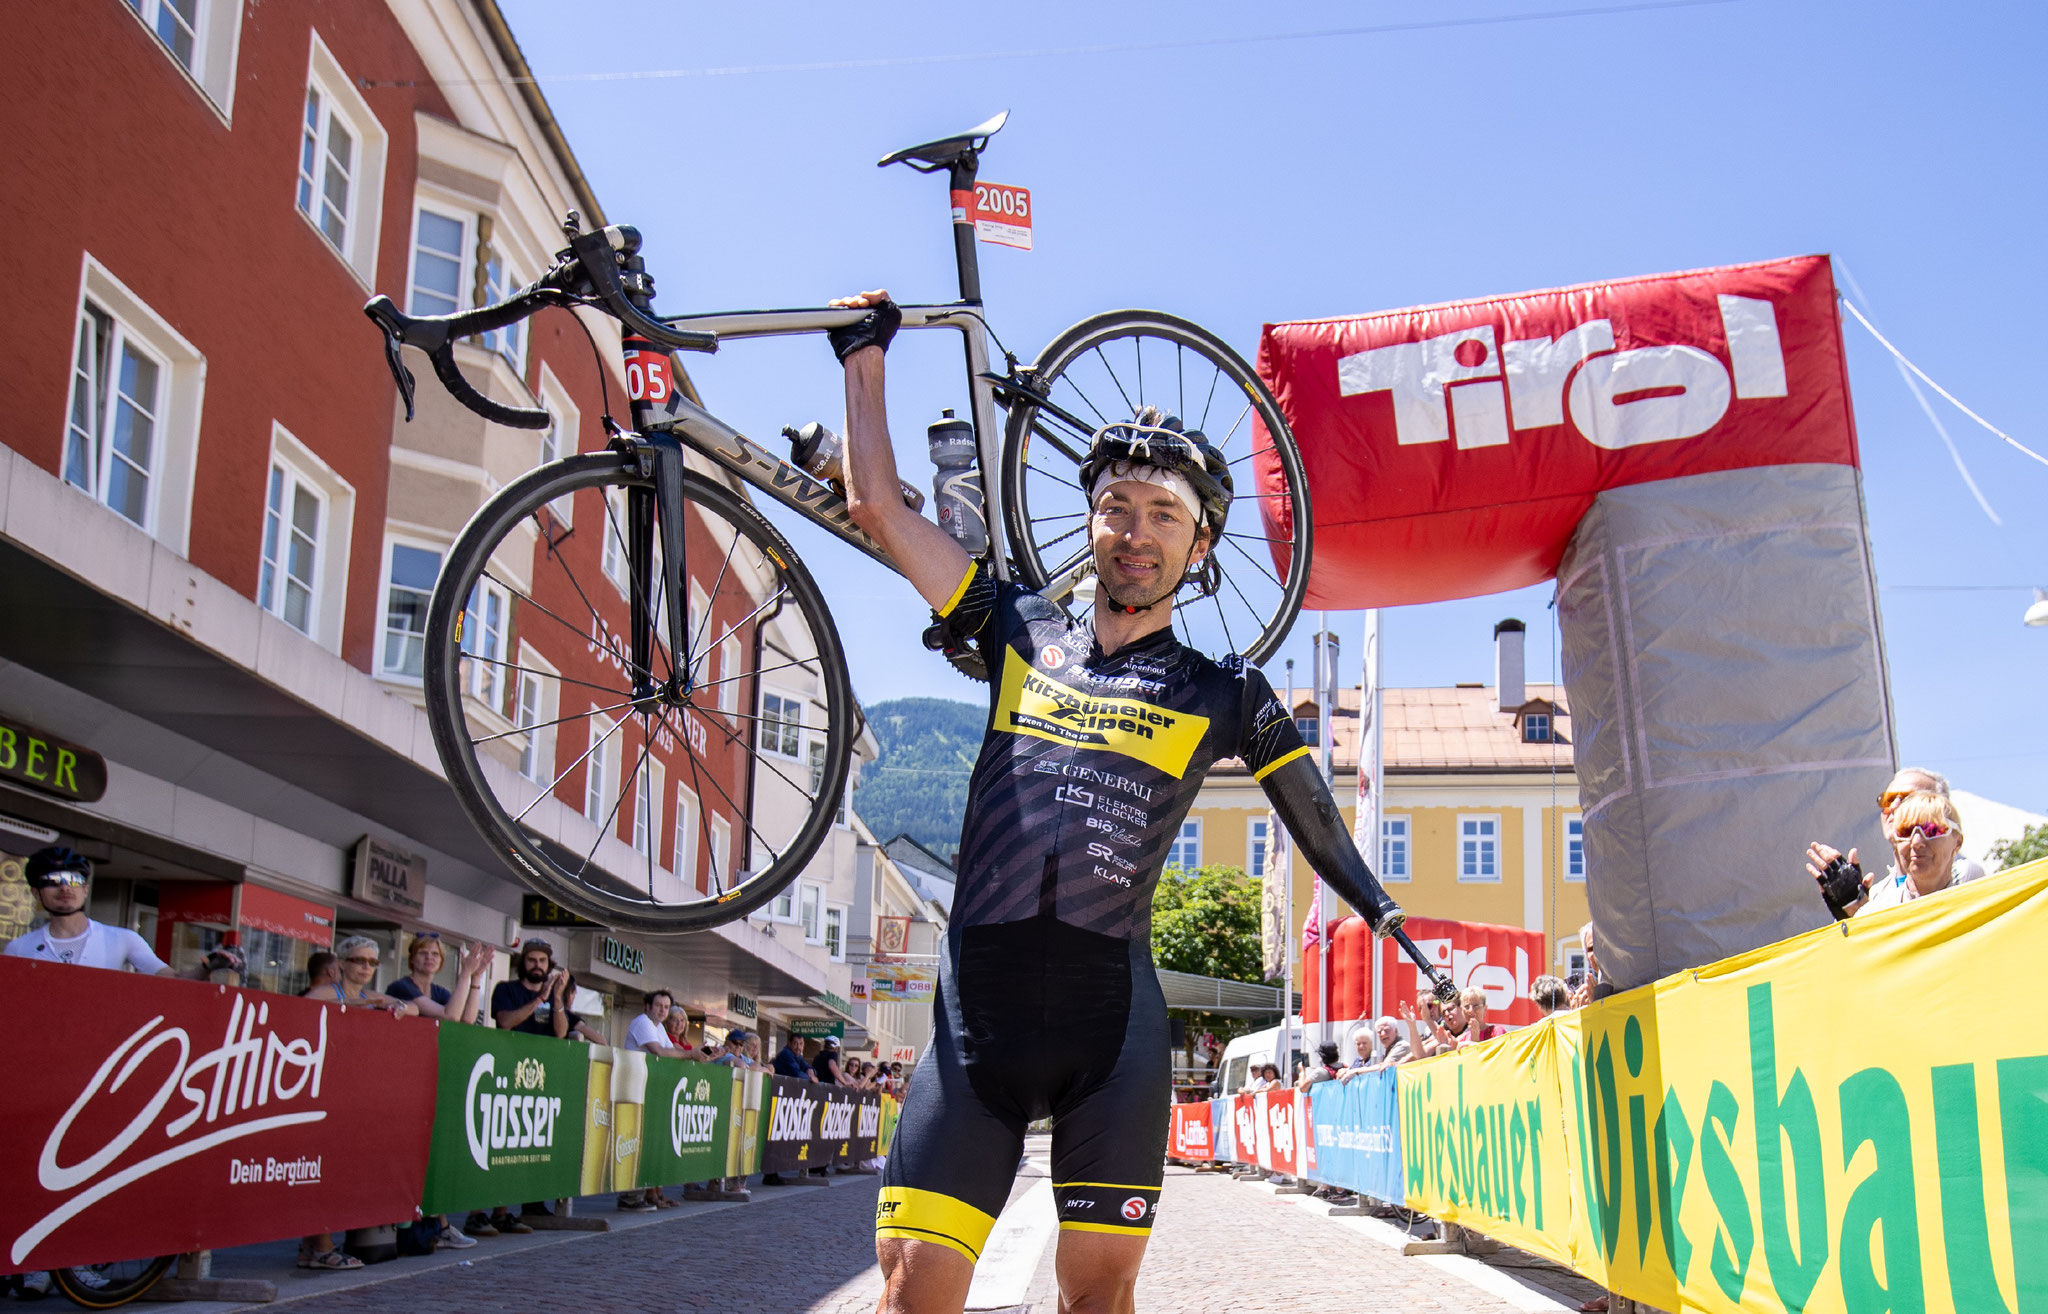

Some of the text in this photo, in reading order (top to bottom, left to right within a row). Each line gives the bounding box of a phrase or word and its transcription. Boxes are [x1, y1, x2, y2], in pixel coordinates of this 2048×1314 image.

[975, 186, 1028, 217] 2005
[1338, 294, 1788, 450] Tirol
[740, 503, 799, 564] CONTINENTAL
[1023, 673, 1175, 729] Kitzbüheler
[1043, 722, 1056, 733] im
[0, 726, 79, 793] BER
[1062, 764, 1152, 802] GENERALI
[1096, 804, 1148, 829] KLOCKER
[1098, 795, 1148, 820] ELEKTRO
[370, 857, 408, 892] PALLA
[1086, 842, 1114, 863] SR
[1093, 865, 1132, 888] KLAFS
[605, 936, 644, 975] DOUGLAS
[1398, 937, 1530, 1010] Tirol
[38, 993, 328, 1192] Osttirol
[465, 1052, 562, 1171] Gösser
[771, 1085, 818, 1141] isostar
[670, 1076, 718, 1158] Gösser
[821, 1092, 855, 1140] isostar
[858, 1096, 880, 1138] isostar
[230, 1155, 322, 1186] Dein Bergtirol
[1405, 1064, 1545, 1232] Wiesbauer
